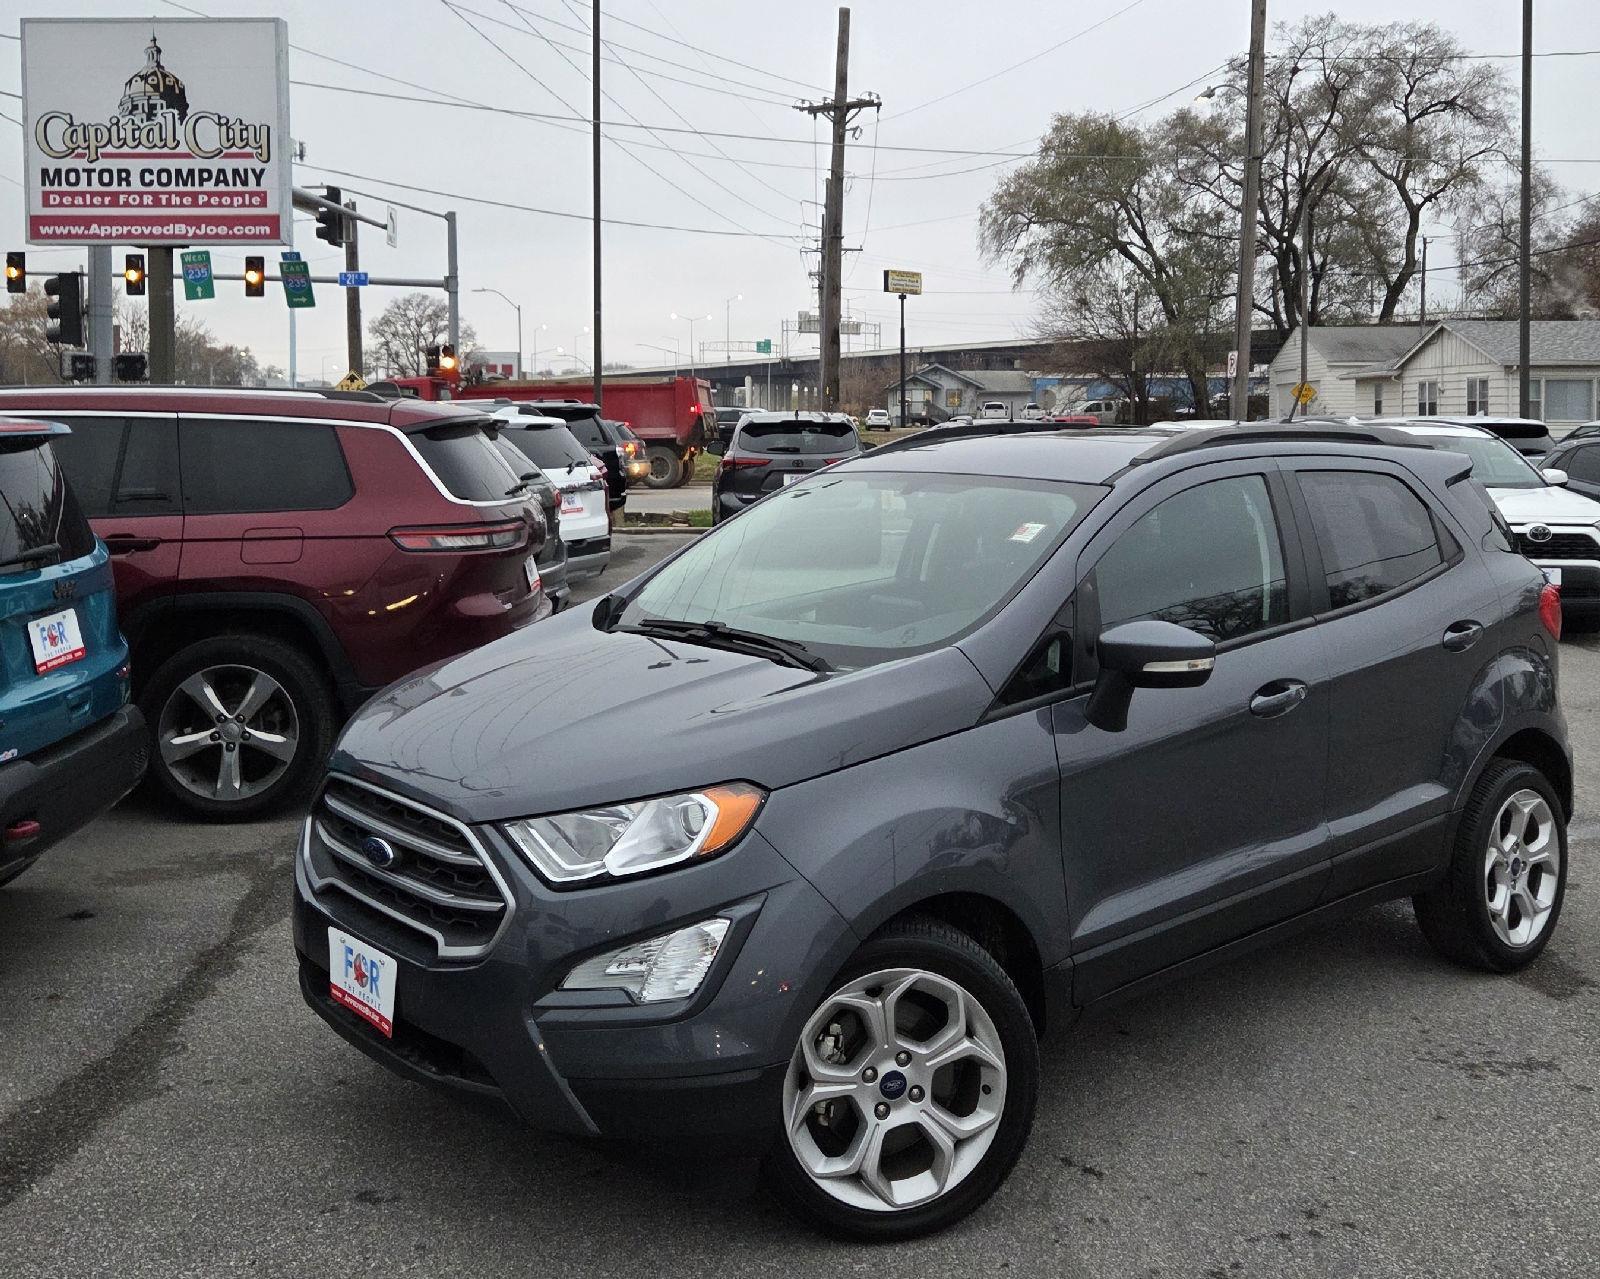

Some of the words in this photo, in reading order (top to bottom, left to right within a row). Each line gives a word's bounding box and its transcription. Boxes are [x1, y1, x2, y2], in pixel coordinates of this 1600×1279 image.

[35, 111, 180, 163] Capital
[184, 111, 270, 163] City
[41, 168, 131, 187] MOTOR
[140, 168, 265, 187] COMPANY
[49, 194, 111, 205] Dealer
[119, 194, 153, 205] FOR
[159, 194, 192, 205] The
[198, 194, 261, 207] People
[39, 223, 271, 237] www.ApprovedByJoe.com
[188, 268, 207, 279] 235
[288, 279, 307, 288] 235
[343, 944, 381, 1000] FOR
